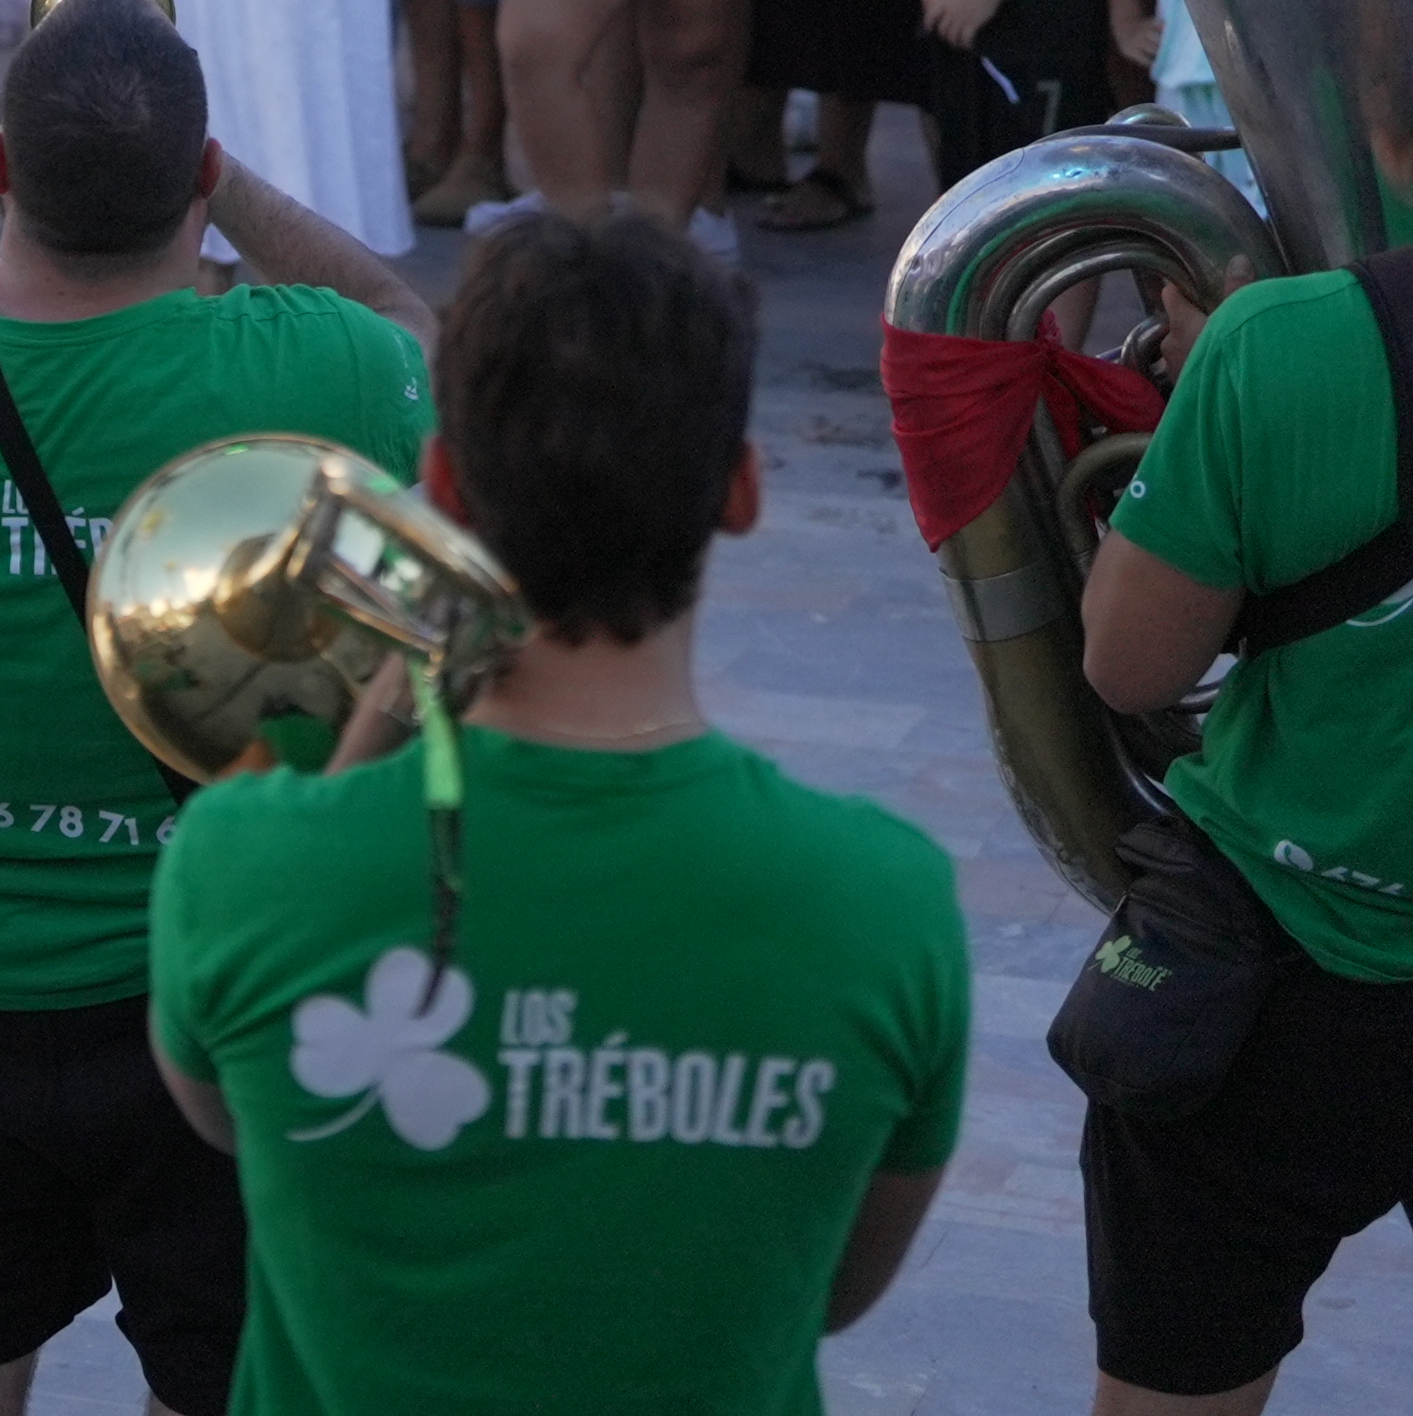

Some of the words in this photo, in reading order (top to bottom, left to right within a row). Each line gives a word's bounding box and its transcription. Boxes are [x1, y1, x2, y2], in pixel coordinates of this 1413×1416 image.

[30, 805, 84, 838] 78
[99, 810, 139, 846] 71
[501, 989, 576, 1046] LOS
[498, 1030, 835, 1149] TRÉBOLES
